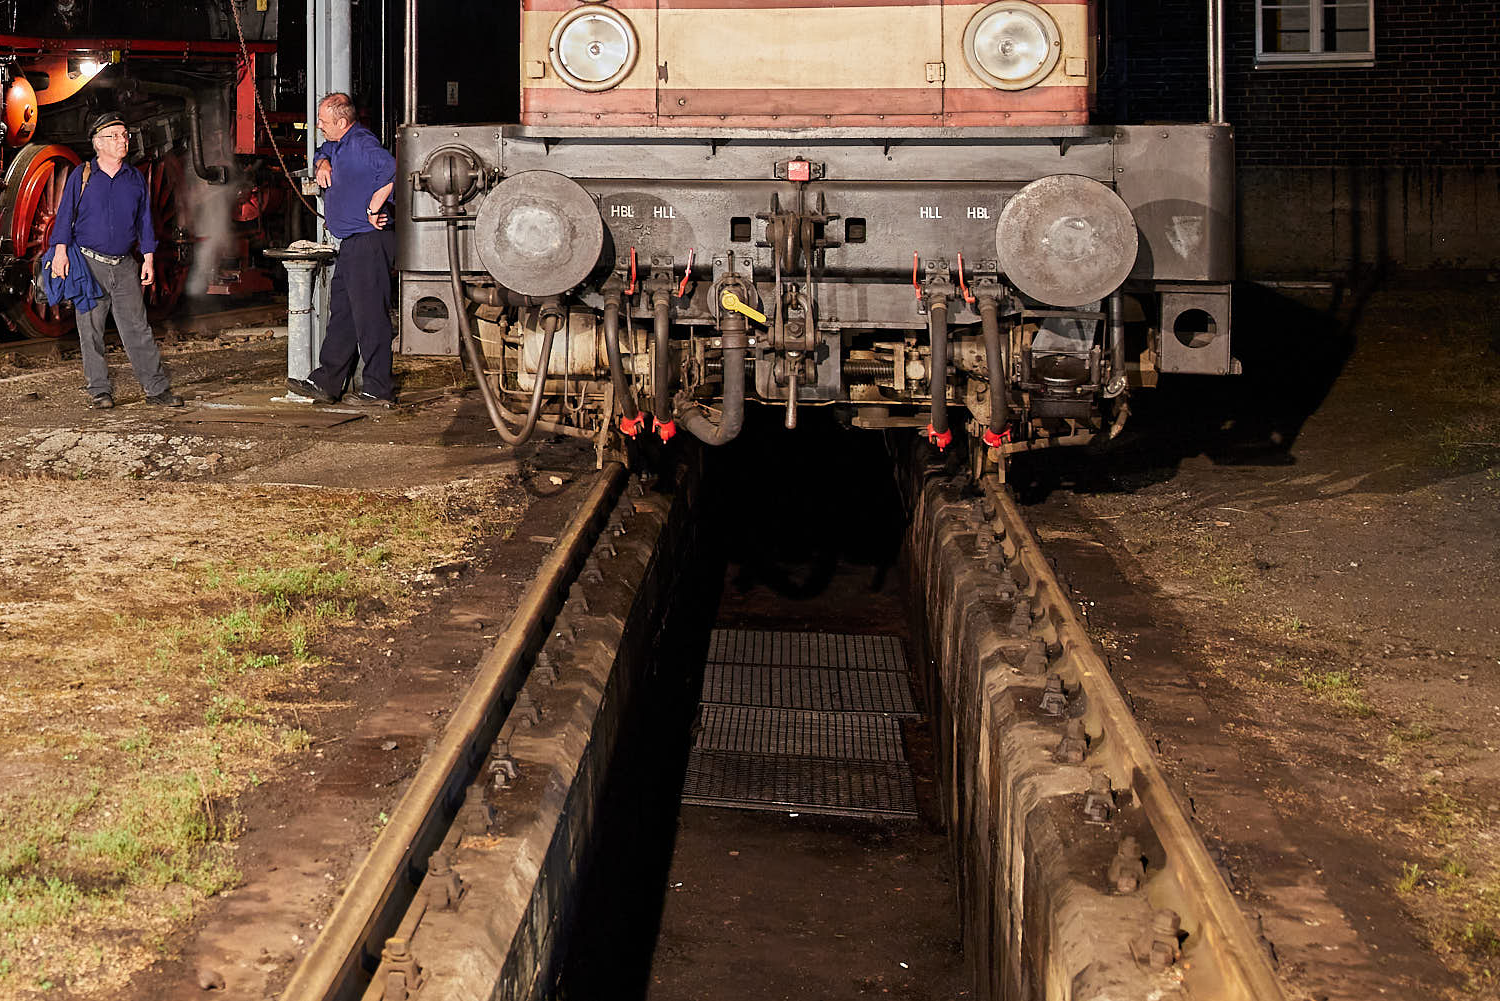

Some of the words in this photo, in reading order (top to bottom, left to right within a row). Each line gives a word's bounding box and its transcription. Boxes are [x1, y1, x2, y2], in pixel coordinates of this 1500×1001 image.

[611, 204, 634, 218] HBL
[653, 205, 676, 219] HLL
[920, 206, 943, 219] HLL
[967, 206, 990, 219] HBL
